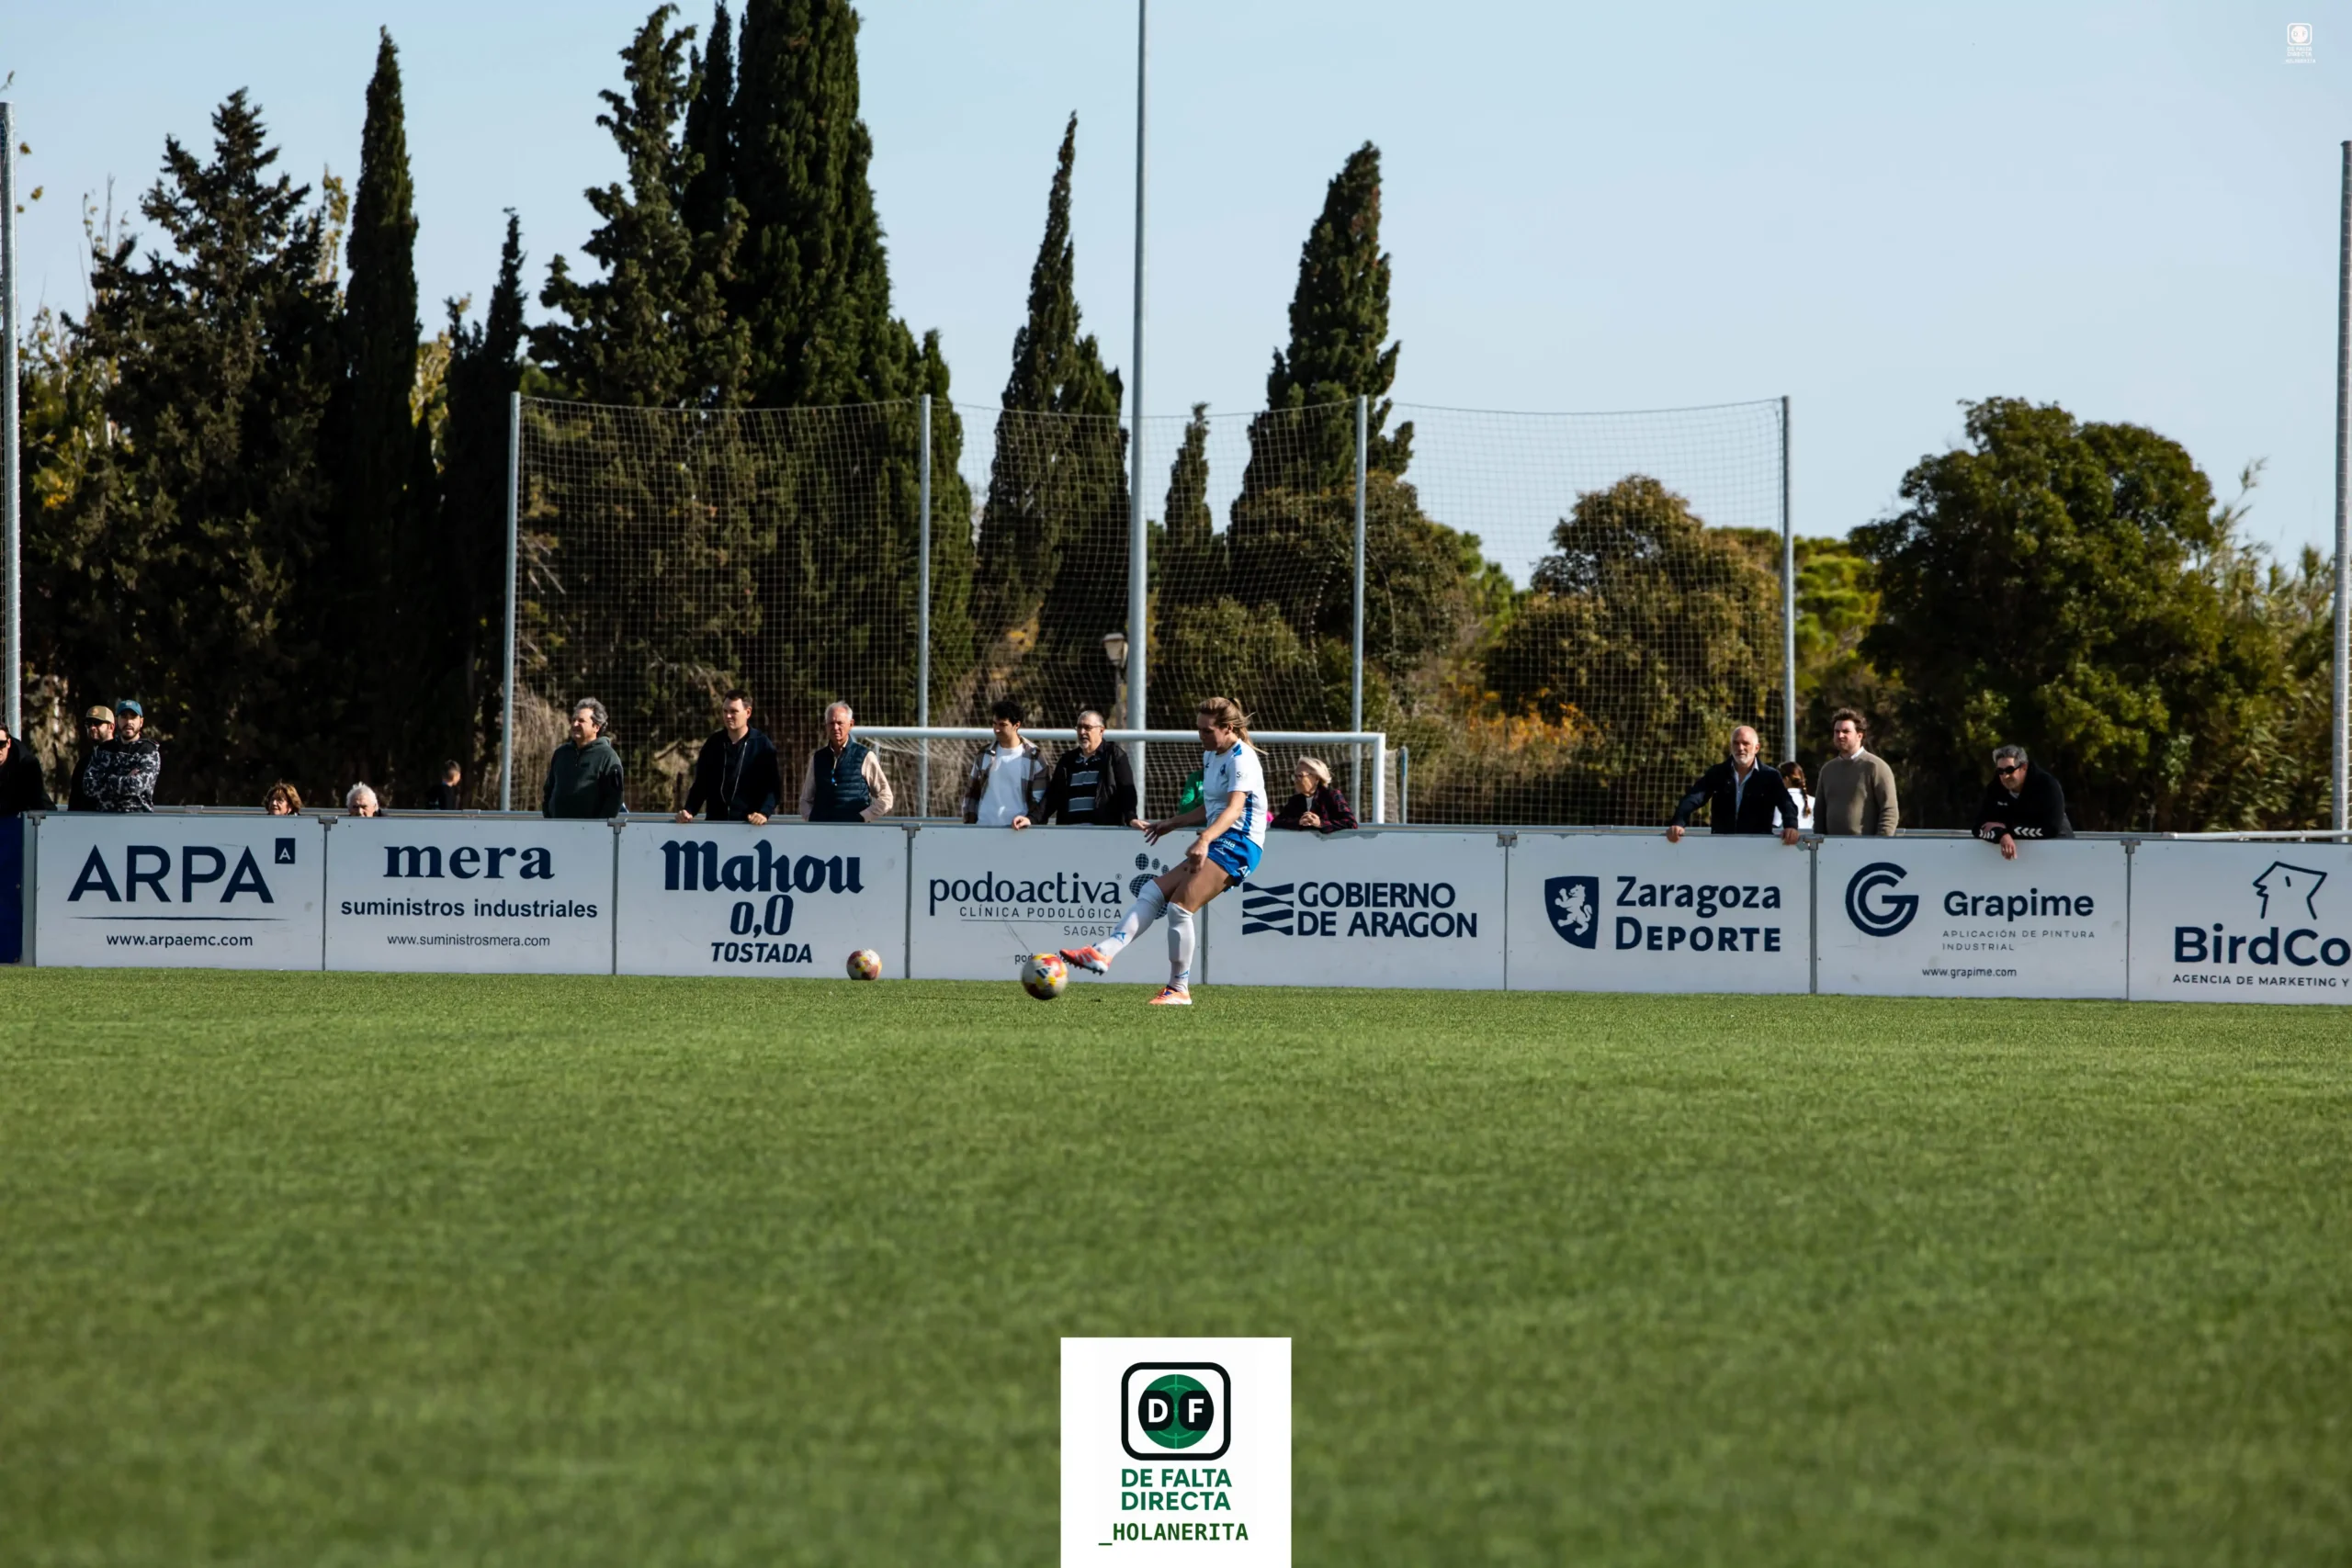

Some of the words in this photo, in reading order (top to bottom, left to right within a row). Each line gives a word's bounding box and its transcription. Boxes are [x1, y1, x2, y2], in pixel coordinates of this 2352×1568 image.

[383, 846, 555, 879] mera
[68, 845, 274, 903] ARPA
[930, 872, 1121, 916] podoactiva
[1298, 882, 1455, 908] GOBIERNO
[1616, 876, 1780, 919] Zaragoza
[1944, 888, 2093, 921] Grapime
[342, 898, 464, 916] suministros
[475, 899, 597, 918] industriales
[960, 904, 1019, 917] CLÍNICA
[1028, 906, 1121, 919] PODOLÓGICA
[1064, 926, 1113, 936] SAGAST
[1298, 911, 1336, 936] DE
[1348, 912, 1476, 937] ARAGON
[1616, 916, 1780, 952] DEPORTE
[1943, 930, 2016, 938] APLICACIÓN
[107, 936, 252, 948] www.arpaemc.com
[388, 934, 549, 946] www.suministrosmera.com
[711, 942, 812, 963] TOSTADA
[1923, 969, 2017, 978] www.grapime.com
[2174, 975, 2231, 984] AGENCIA
[2237, 976, 2253, 985] DE
[2259, 977, 2335, 987] MARKETING
